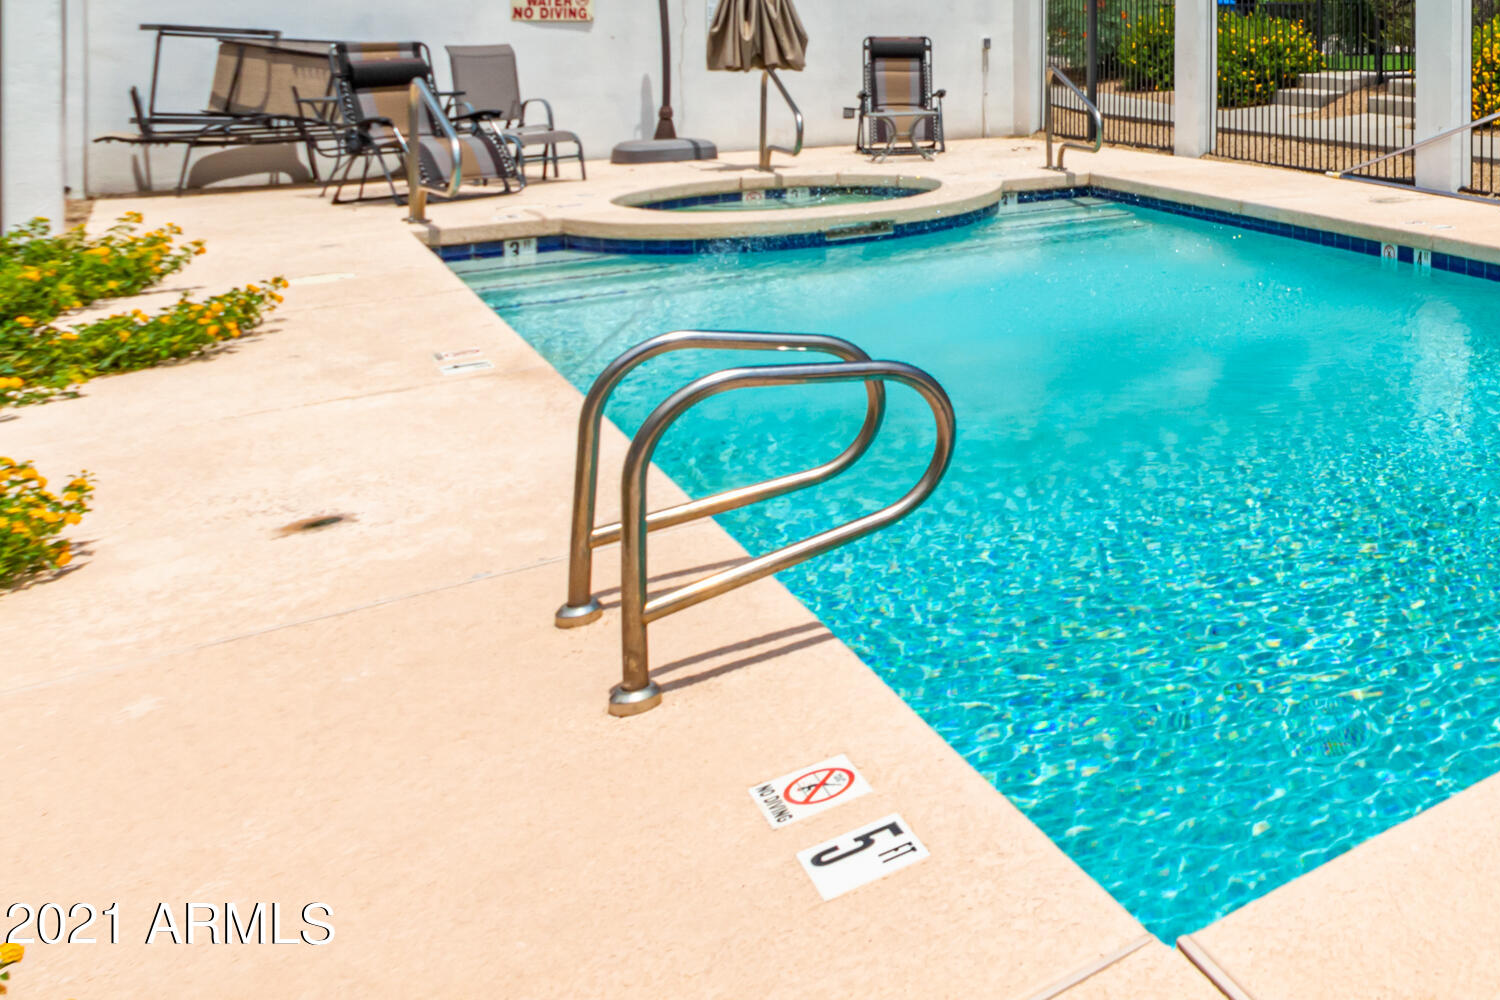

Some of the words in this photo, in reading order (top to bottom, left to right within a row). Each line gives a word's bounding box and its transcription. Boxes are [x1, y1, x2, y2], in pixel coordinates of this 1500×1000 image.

[512, 7, 534, 19] NO
[539, 7, 588, 19] DIVING
[755, 783, 775, 797] NO
[764, 795, 793, 823] DIVING
[811, 821, 904, 867] 5
[877, 841, 918, 864] FT
